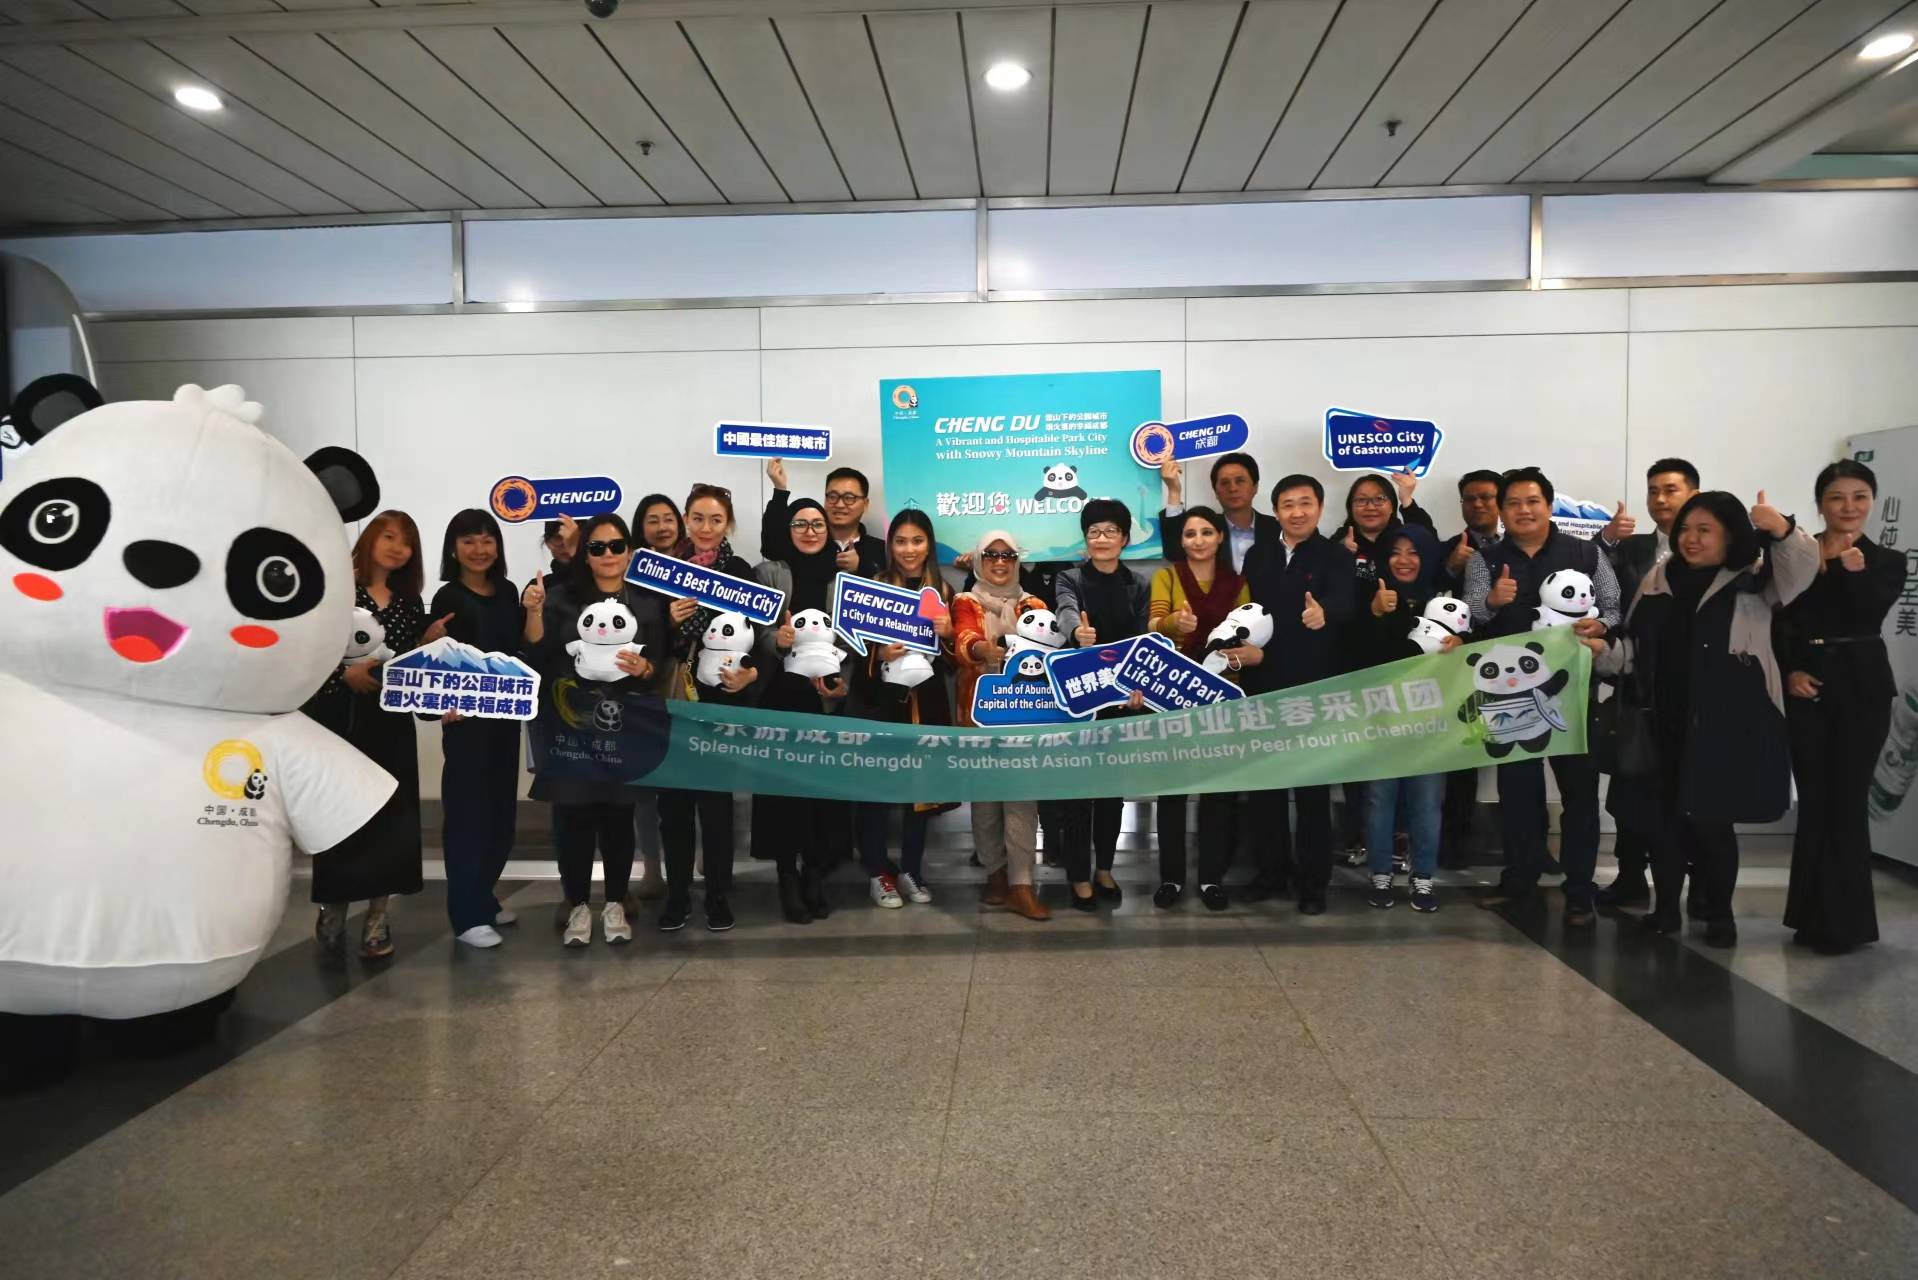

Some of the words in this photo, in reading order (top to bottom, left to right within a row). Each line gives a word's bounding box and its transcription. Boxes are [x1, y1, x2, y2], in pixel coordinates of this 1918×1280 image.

[935, 416, 1006, 434] CHENG
[1010, 415, 1041, 431] DU
[1179, 427, 1214, 440] CHENG
[1216, 424, 1231, 434] DU
[936, 438, 943, 446] A
[945, 437, 983, 446] Vibrant
[984, 436, 1004, 445] and
[1006, 434, 1060, 446] Hospitable
[1062, 433, 1086, 442] Park
[1088, 432, 1107, 443] City
[1195, 435, 1218, 450] 成都
[1338, 432, 1393, 444] UNESCO
[1397, 431, 1424, 443] City
[936, 449, 961, 460] with
[964, 449, 1002, 461] Snowy
[1005, 447, 1061, 458] Mountain
[1064, 445, 1108, 457] Skyline
[1338, 446, 1351, 455] of
[1353, 445, 1425, 455] Gastronomy
[540, 490, 616, 505] CHENGDU
[936, 492, 1010, 517] 歡迎您
[1016, 496, 1111, 514] WELCO
[682, 572, 710, 593] Best
[711, 581, 751, 606] Tourist
[752, 594, 777, 616] City
[844, 589, 915, 616] CHENGDU
[843, 609, 848, 617] a
[849, 609, 865, 624] City
[866, 612, 878, 625] for
[879, 617, 884, 626] a
[885, 618, 918, 637] Relaxing
[919, 626, 933, 638] Life
[386, 669, 533, 695] 雪山下的公園城市
[1065, 663, 1122, 698] 世界美
[1135, 647, 1168, 675] City
[1169, 669, 1191, 685] of
[1187, 676, 1231, 704] Park
[992, 684, 1013, 695] Land
[1014, 684, 1024, 695] of
[1025, 684, 1053, 695] Abund
[1124, 664, 1150, 686] Life
[1150, 678, 1166, 696] in
[1166, 688, 1199, 709] Poet
[978, 699, 1008, 711] Capital
[1009, 699, 1019, 709] of
[1020, 699, 1033, 709] the
[688, 736, 769, 758] Splendid
[775, 749, 815, 763] Tour
[820, 750, 835, 766] in
[947, 755, 1039, 769] Southeast
[1042, 754, 1091, 768] Asian
[1095, 748, 1168, 766] Tourism
[1173, 742, 1245, 760] Industry
[1251, 737, 1292, 753] Peer
[1296, 733, 1337, 749] Tour
[1343, 730, 1360, 744] in
[1364, 717, 1448, 741] Chengdu
